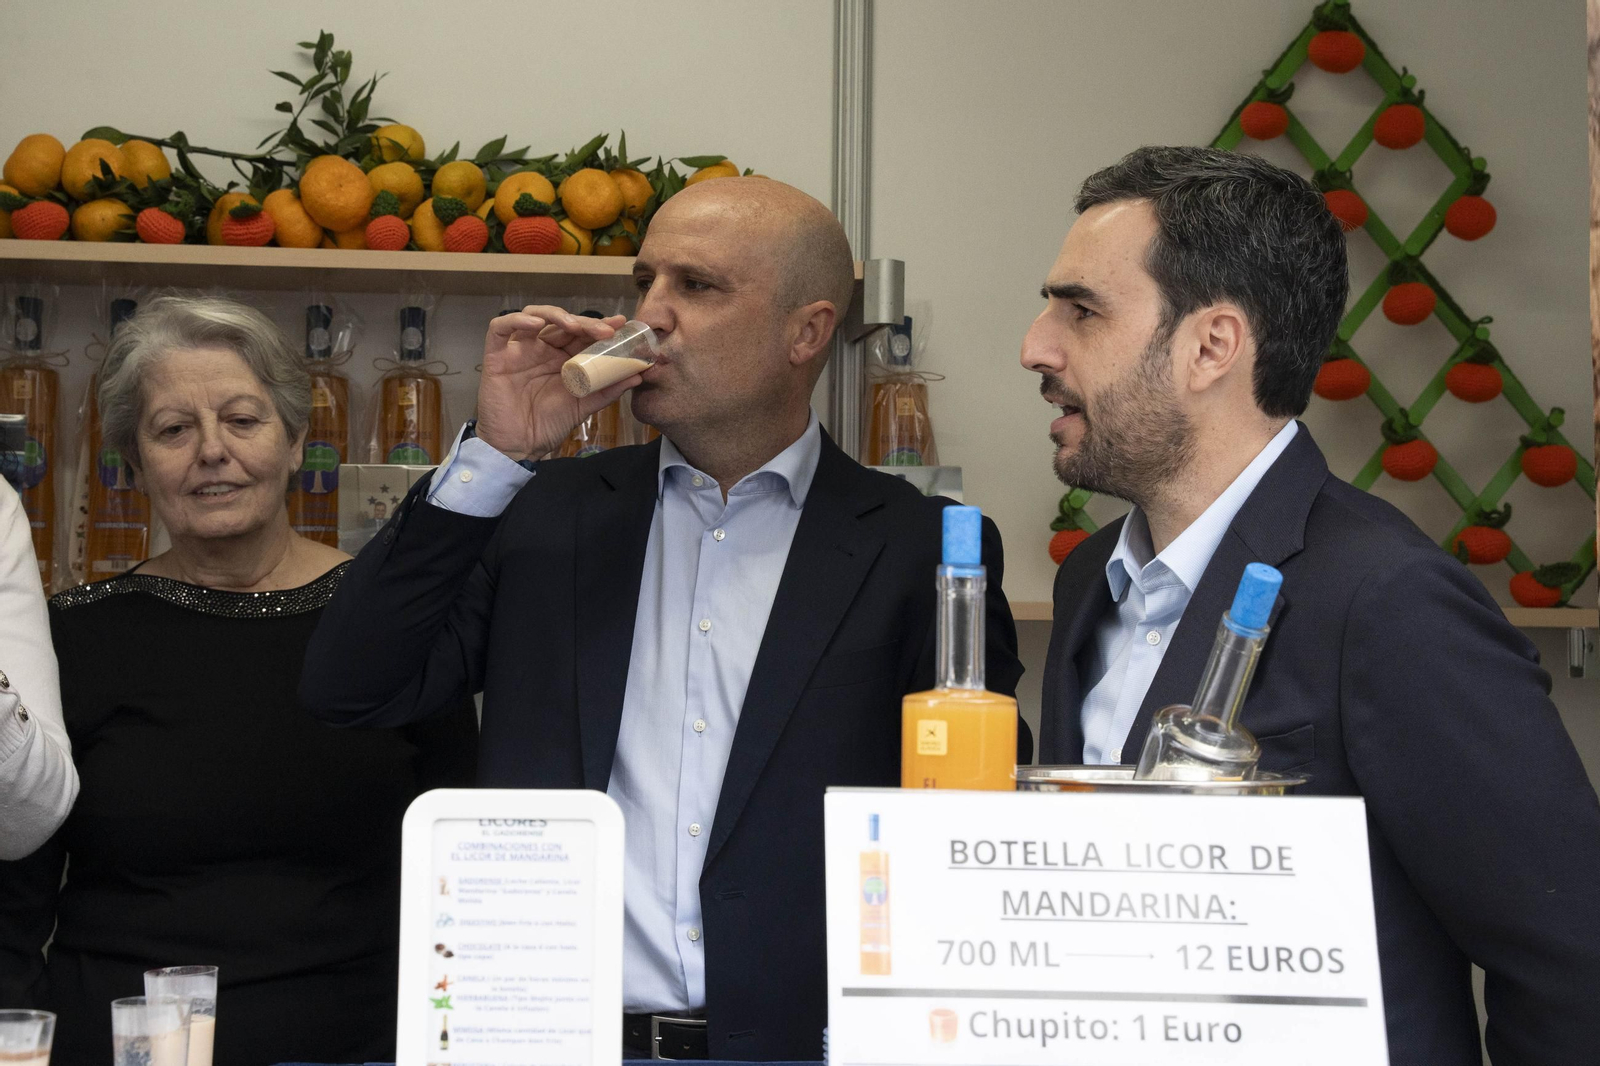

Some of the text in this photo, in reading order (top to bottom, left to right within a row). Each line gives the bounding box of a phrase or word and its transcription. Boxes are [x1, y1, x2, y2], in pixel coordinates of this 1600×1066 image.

[457, 842, 562, 851] COMBINACIONES CON
[464, 853, 492, 861] LICOR
[495, 853, 506, 861] DE
[510, 853, 570, 862] MANDARINA
[949, 839, 1295, 871] BOTELLA LICOR DE
[1001, 889, 1238, 920] MANDARINA:
[937, 940, 1346, 974] 700 ML 12 EUROS
[969, 1010, 1243, 1047] Chupito: 1 Euro
